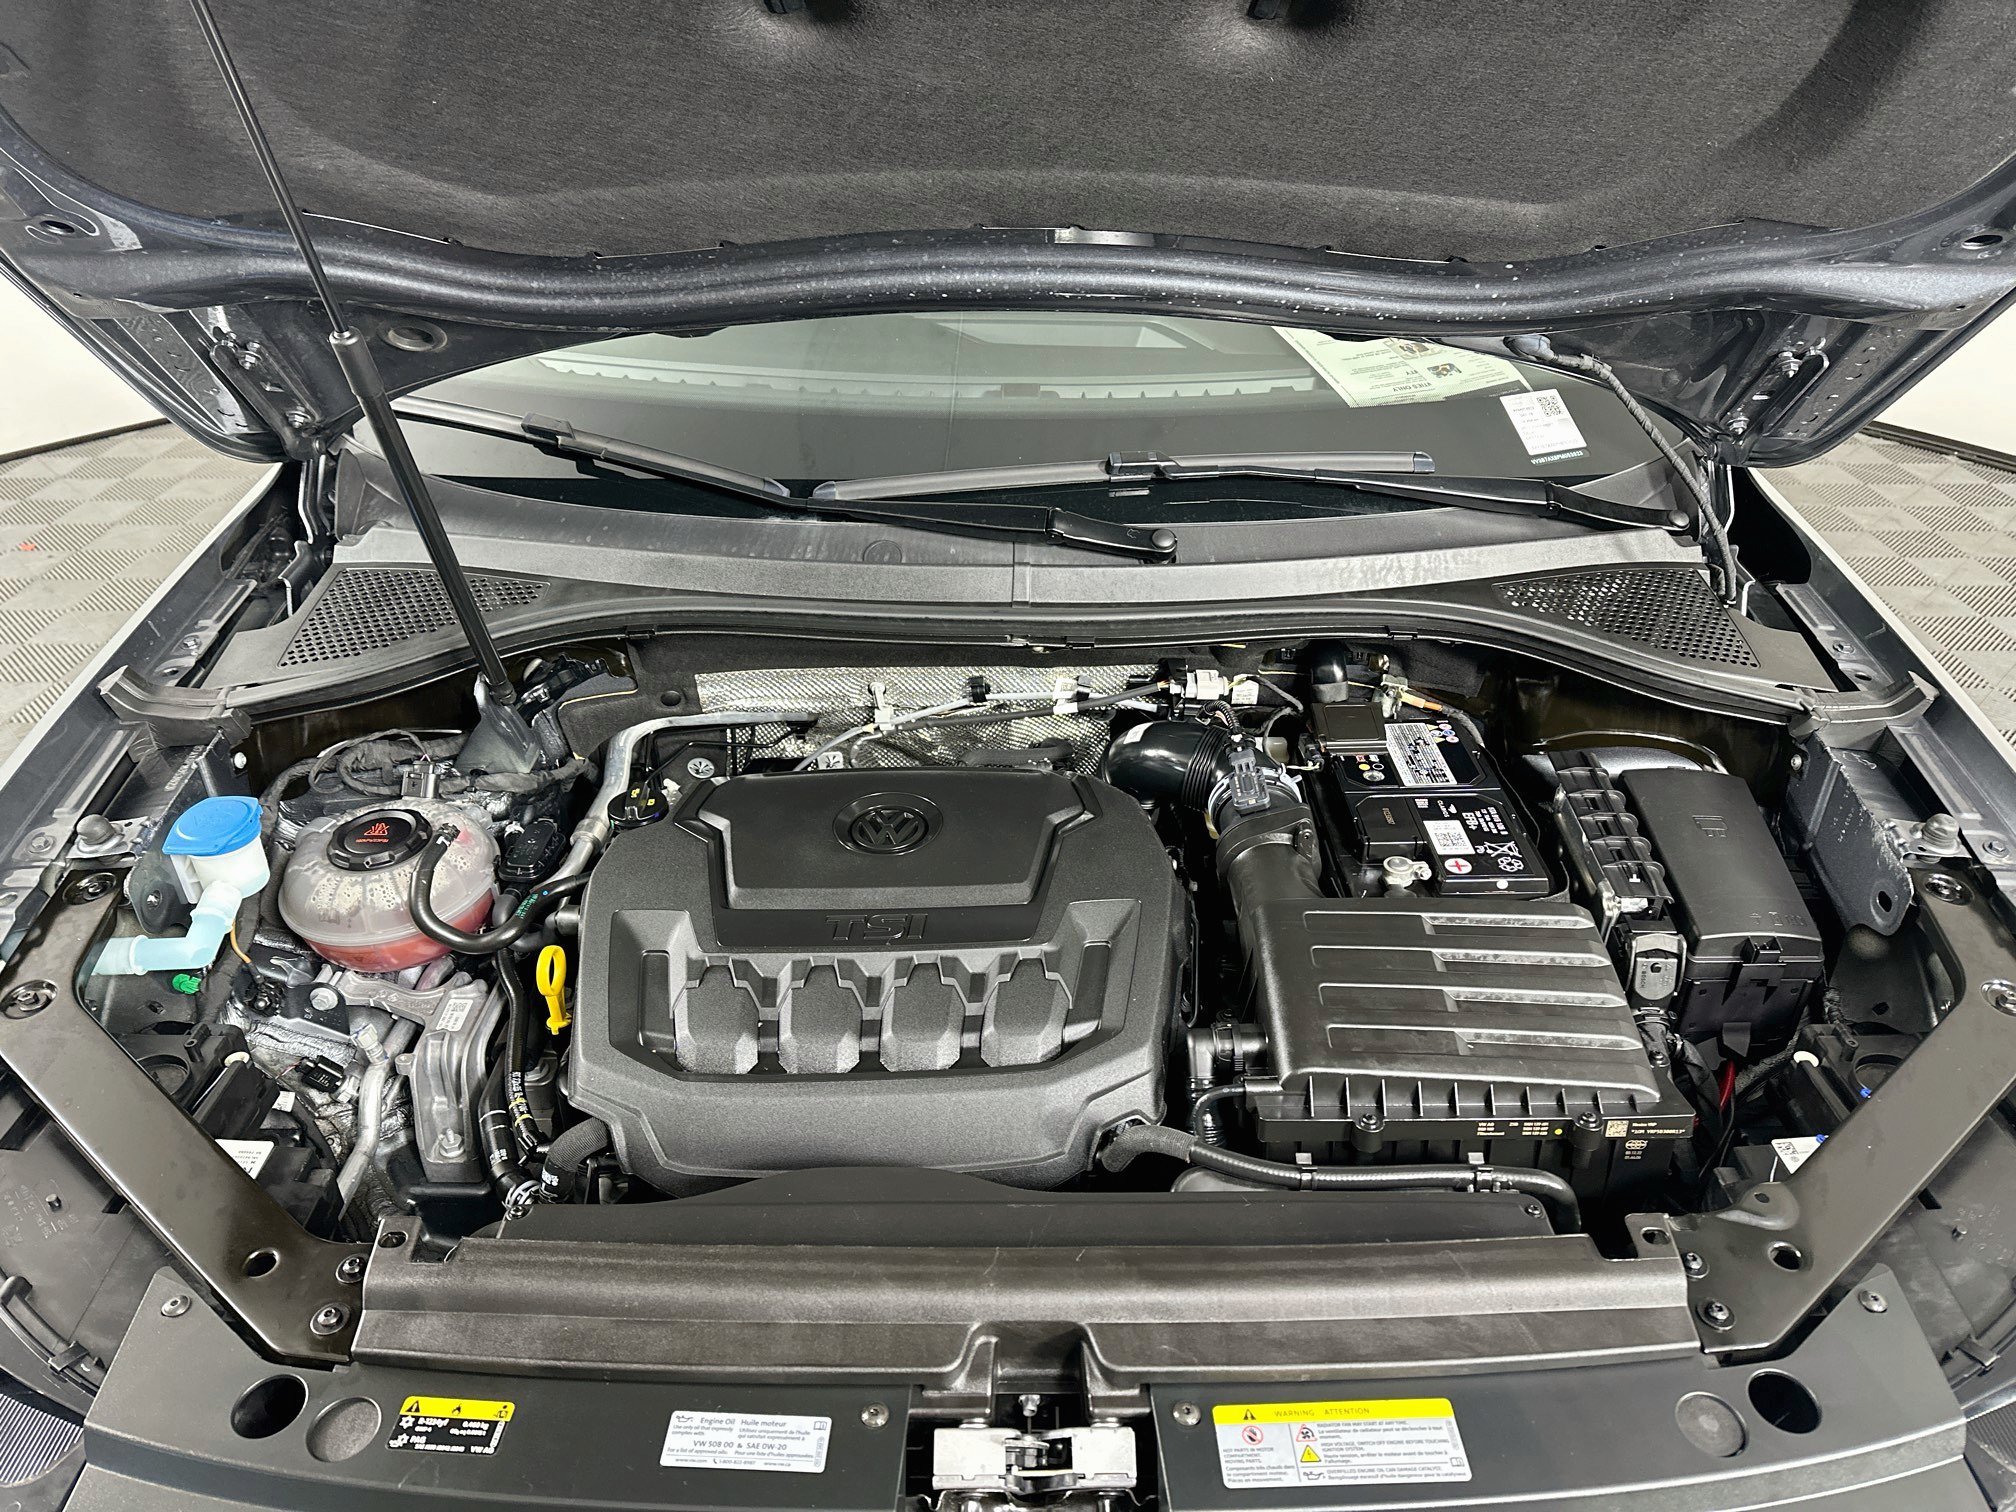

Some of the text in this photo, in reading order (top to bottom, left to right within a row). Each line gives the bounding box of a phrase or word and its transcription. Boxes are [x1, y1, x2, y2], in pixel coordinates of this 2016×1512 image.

[1462, 812, 1479, 830] EFB+
[826, 913, 928, 940] TSI
[1274, 1408, 1370, 1417] WARNING ATTENTION
[410, 1435, 426, 1444] PAG
